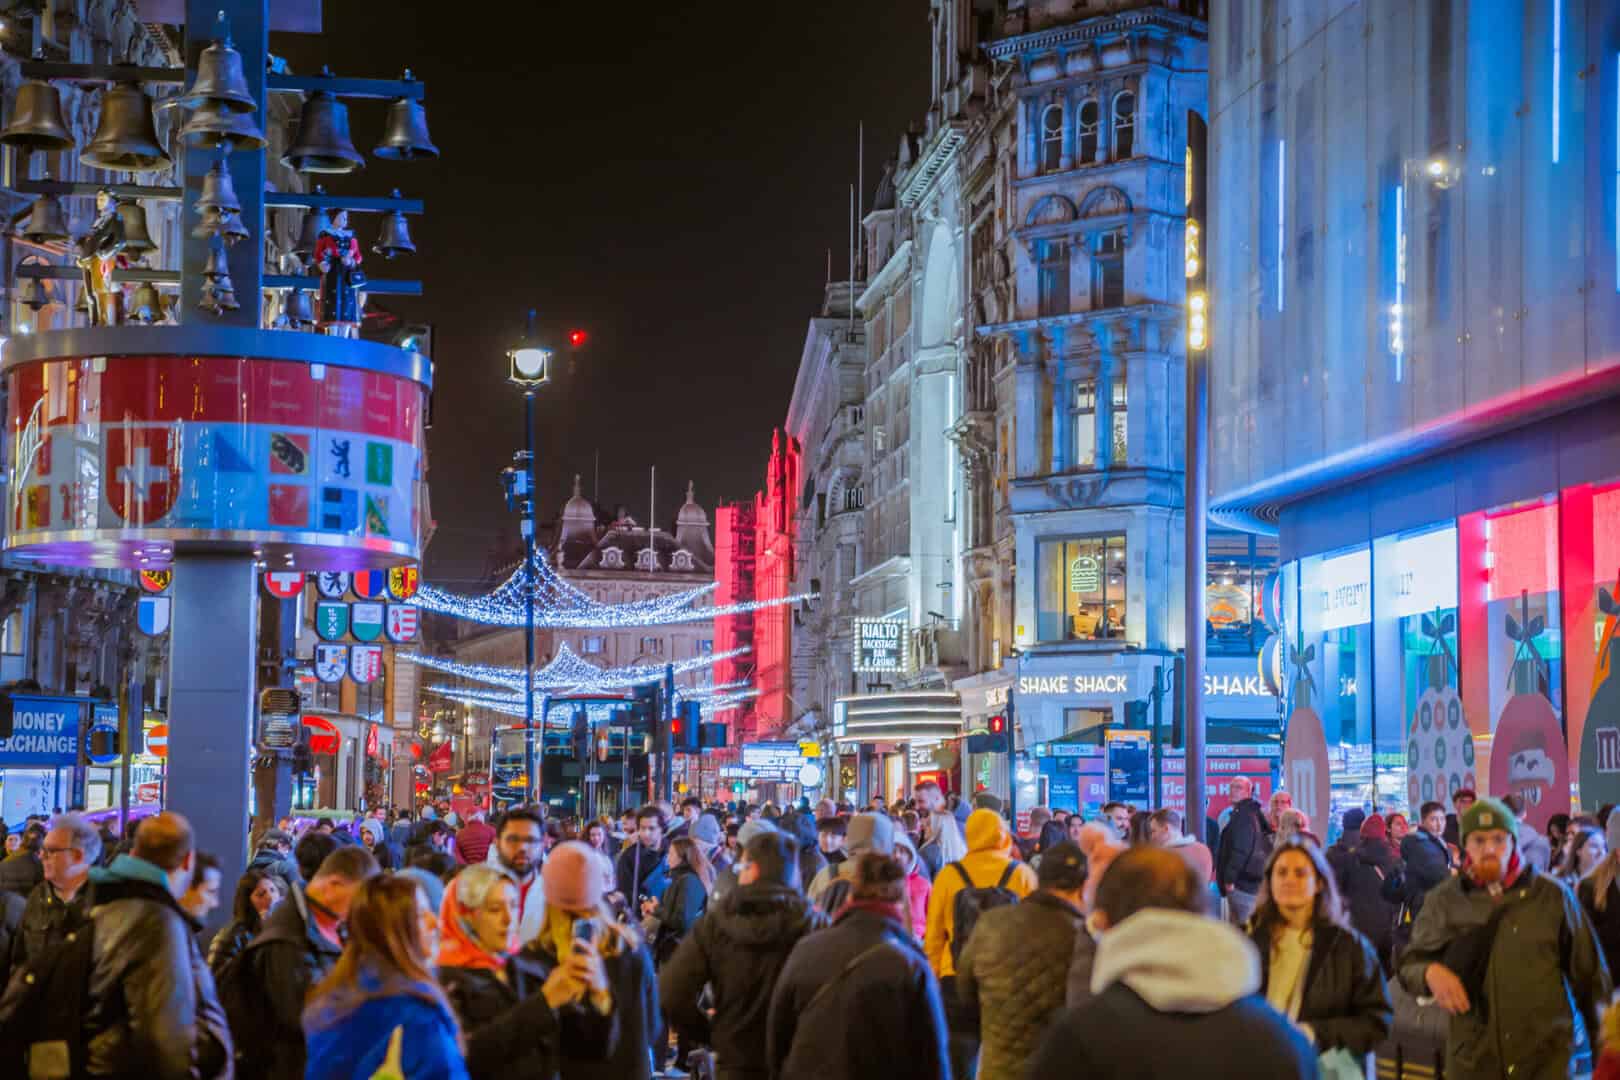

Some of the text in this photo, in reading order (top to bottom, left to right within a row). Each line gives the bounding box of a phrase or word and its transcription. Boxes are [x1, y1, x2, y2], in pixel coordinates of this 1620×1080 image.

[862, 623, 898, 638] RIALTO
[862, 639, 897, 649] BACKSTAGE
[872, 656, 896, 665] CASINO
[1019, 674, 1128, 694] SHAKE SHACK
[12, 711, 65, 731] MONEY
